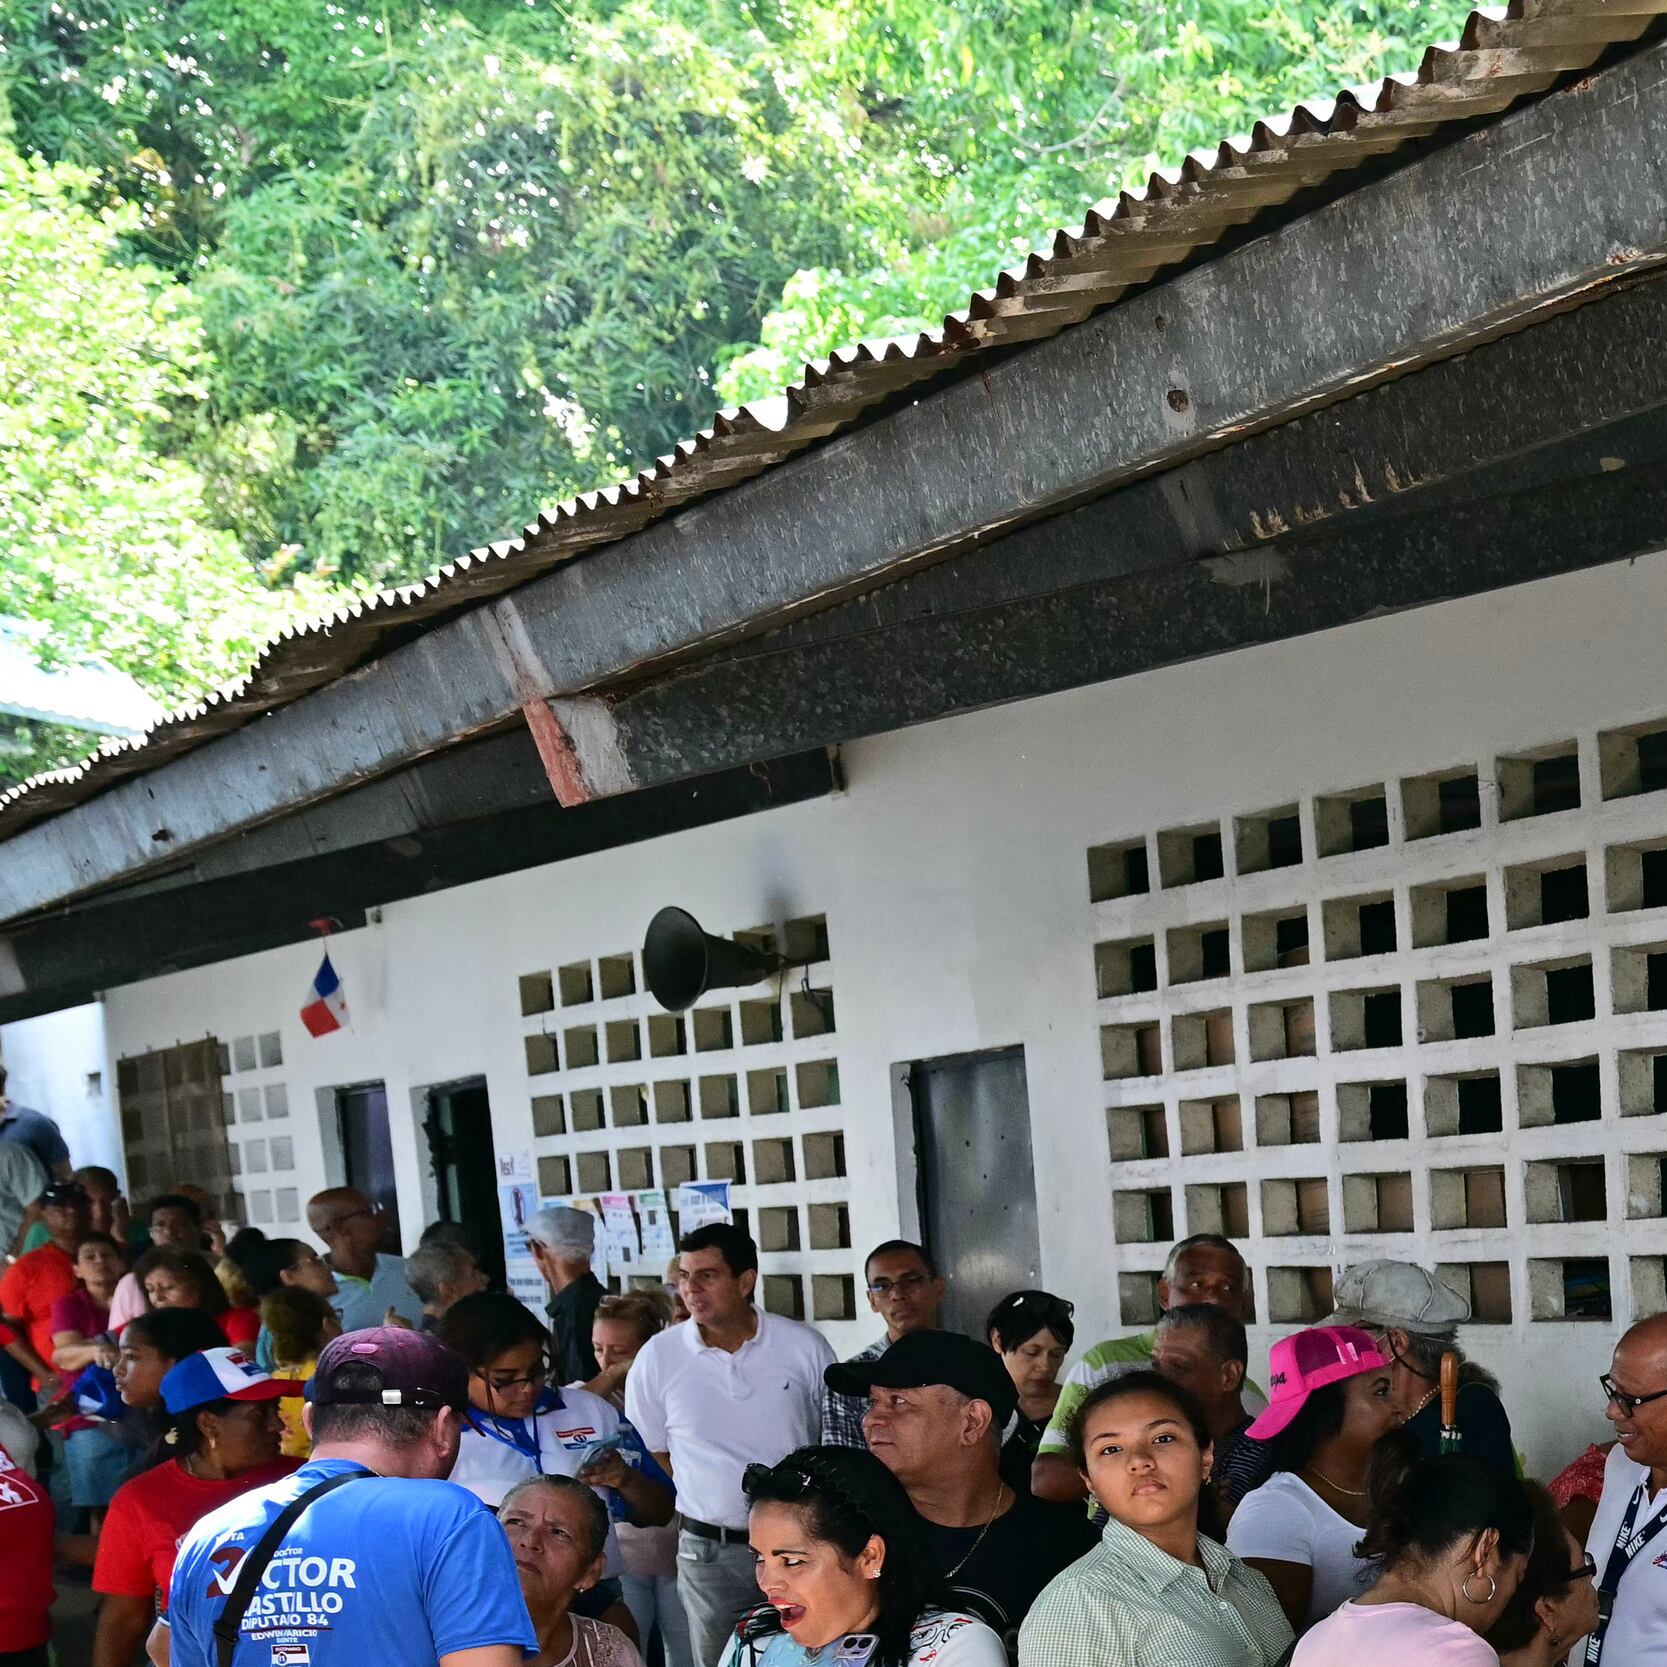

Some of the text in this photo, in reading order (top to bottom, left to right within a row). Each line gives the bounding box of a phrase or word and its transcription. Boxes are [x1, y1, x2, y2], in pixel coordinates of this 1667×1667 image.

[1616, 1525, 1631, 1550] NIKE
[1625, 1533, 1646, 1560] NIKE
[243, 1591, 343, 1617] ASTILLO
[241, 1613, 329, 1631] DIPUTAO 84
[1586, 1636, 1601, 1664] NIKE
